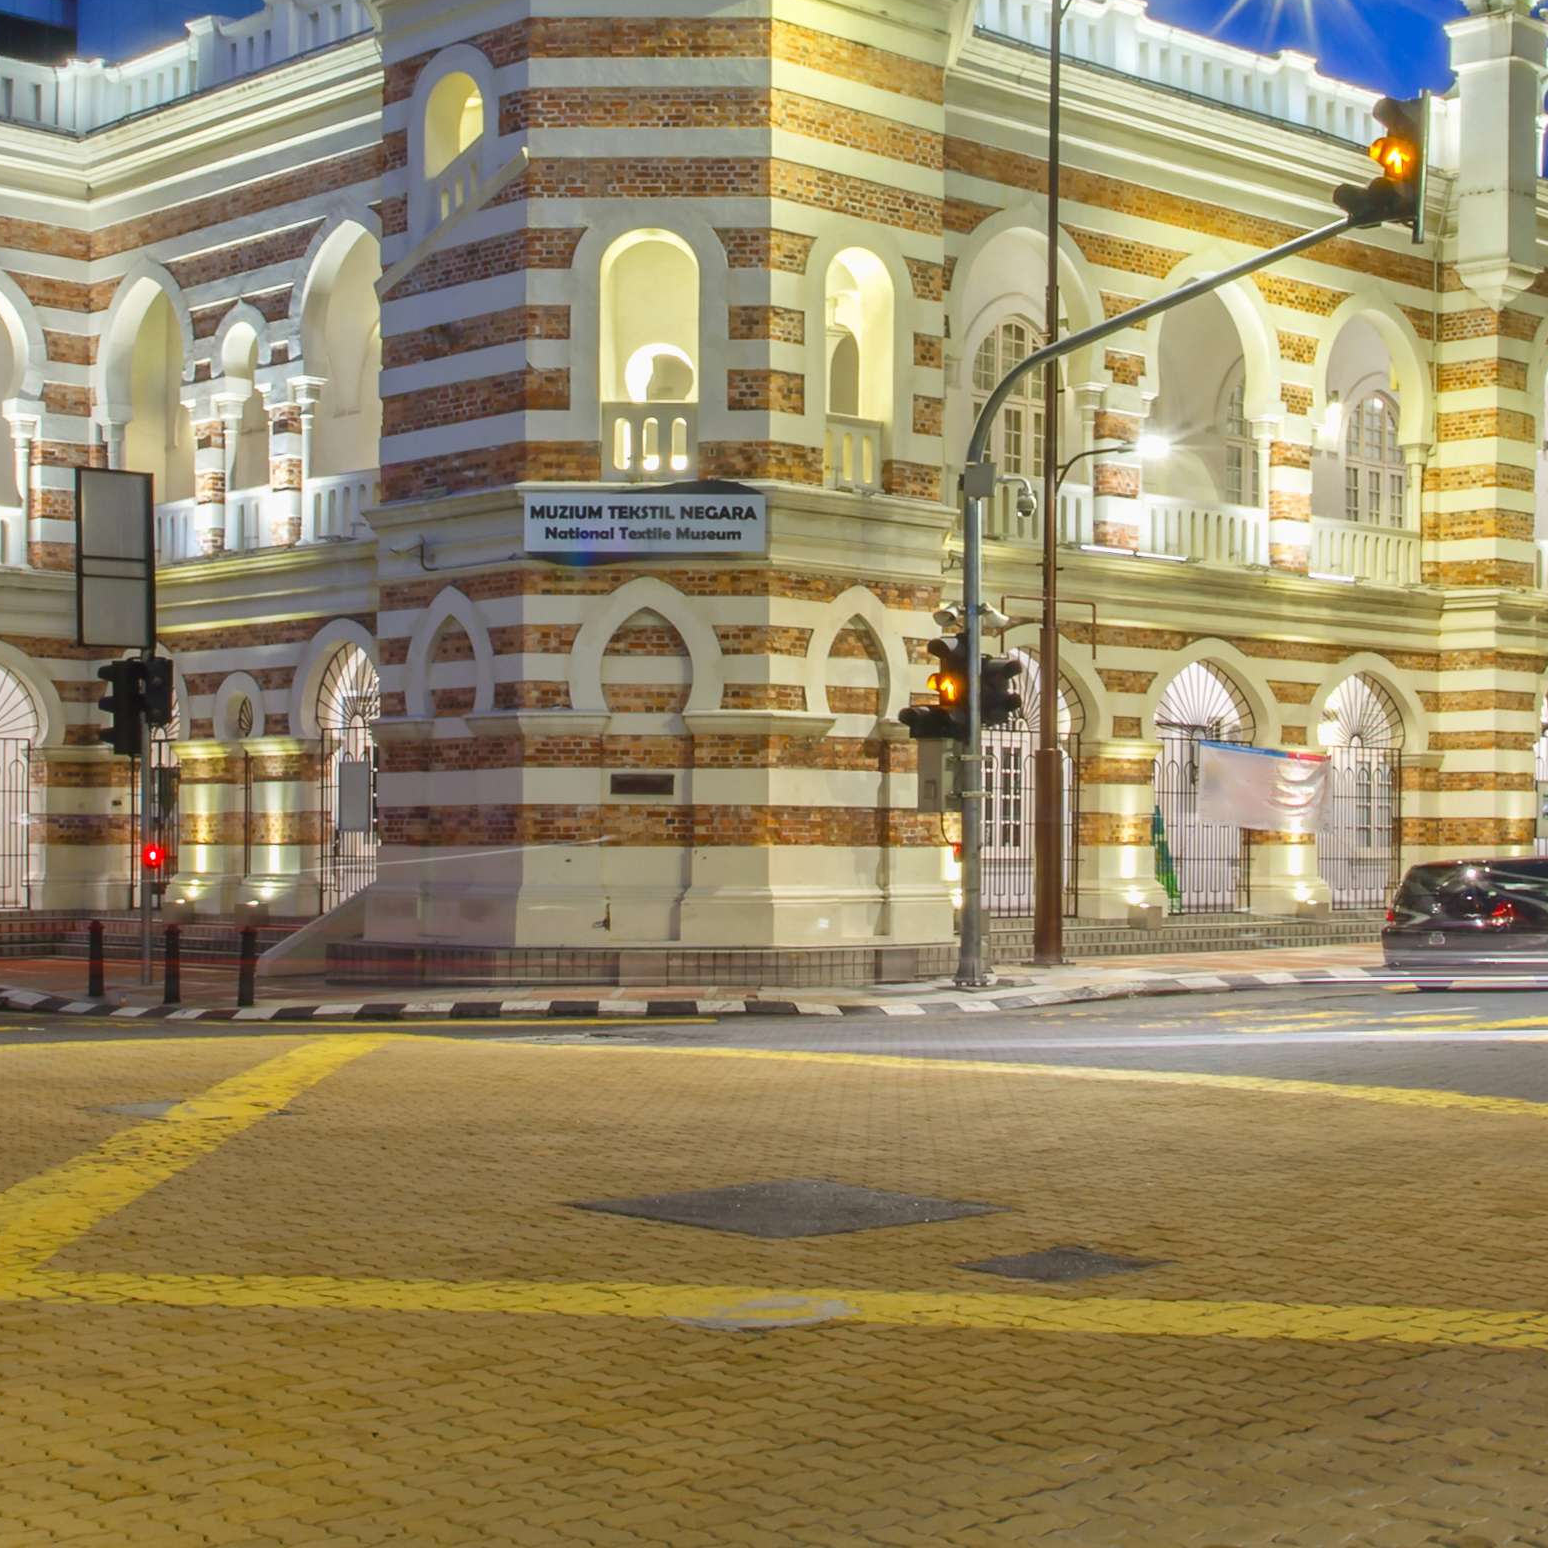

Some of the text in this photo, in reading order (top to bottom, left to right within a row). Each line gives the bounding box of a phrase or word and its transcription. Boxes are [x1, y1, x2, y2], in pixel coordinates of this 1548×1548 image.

[530, 505, 758, 521] MUZIUM TEKSTIL NEGARA
[545, 527, 742, 540] National Textile Museum
